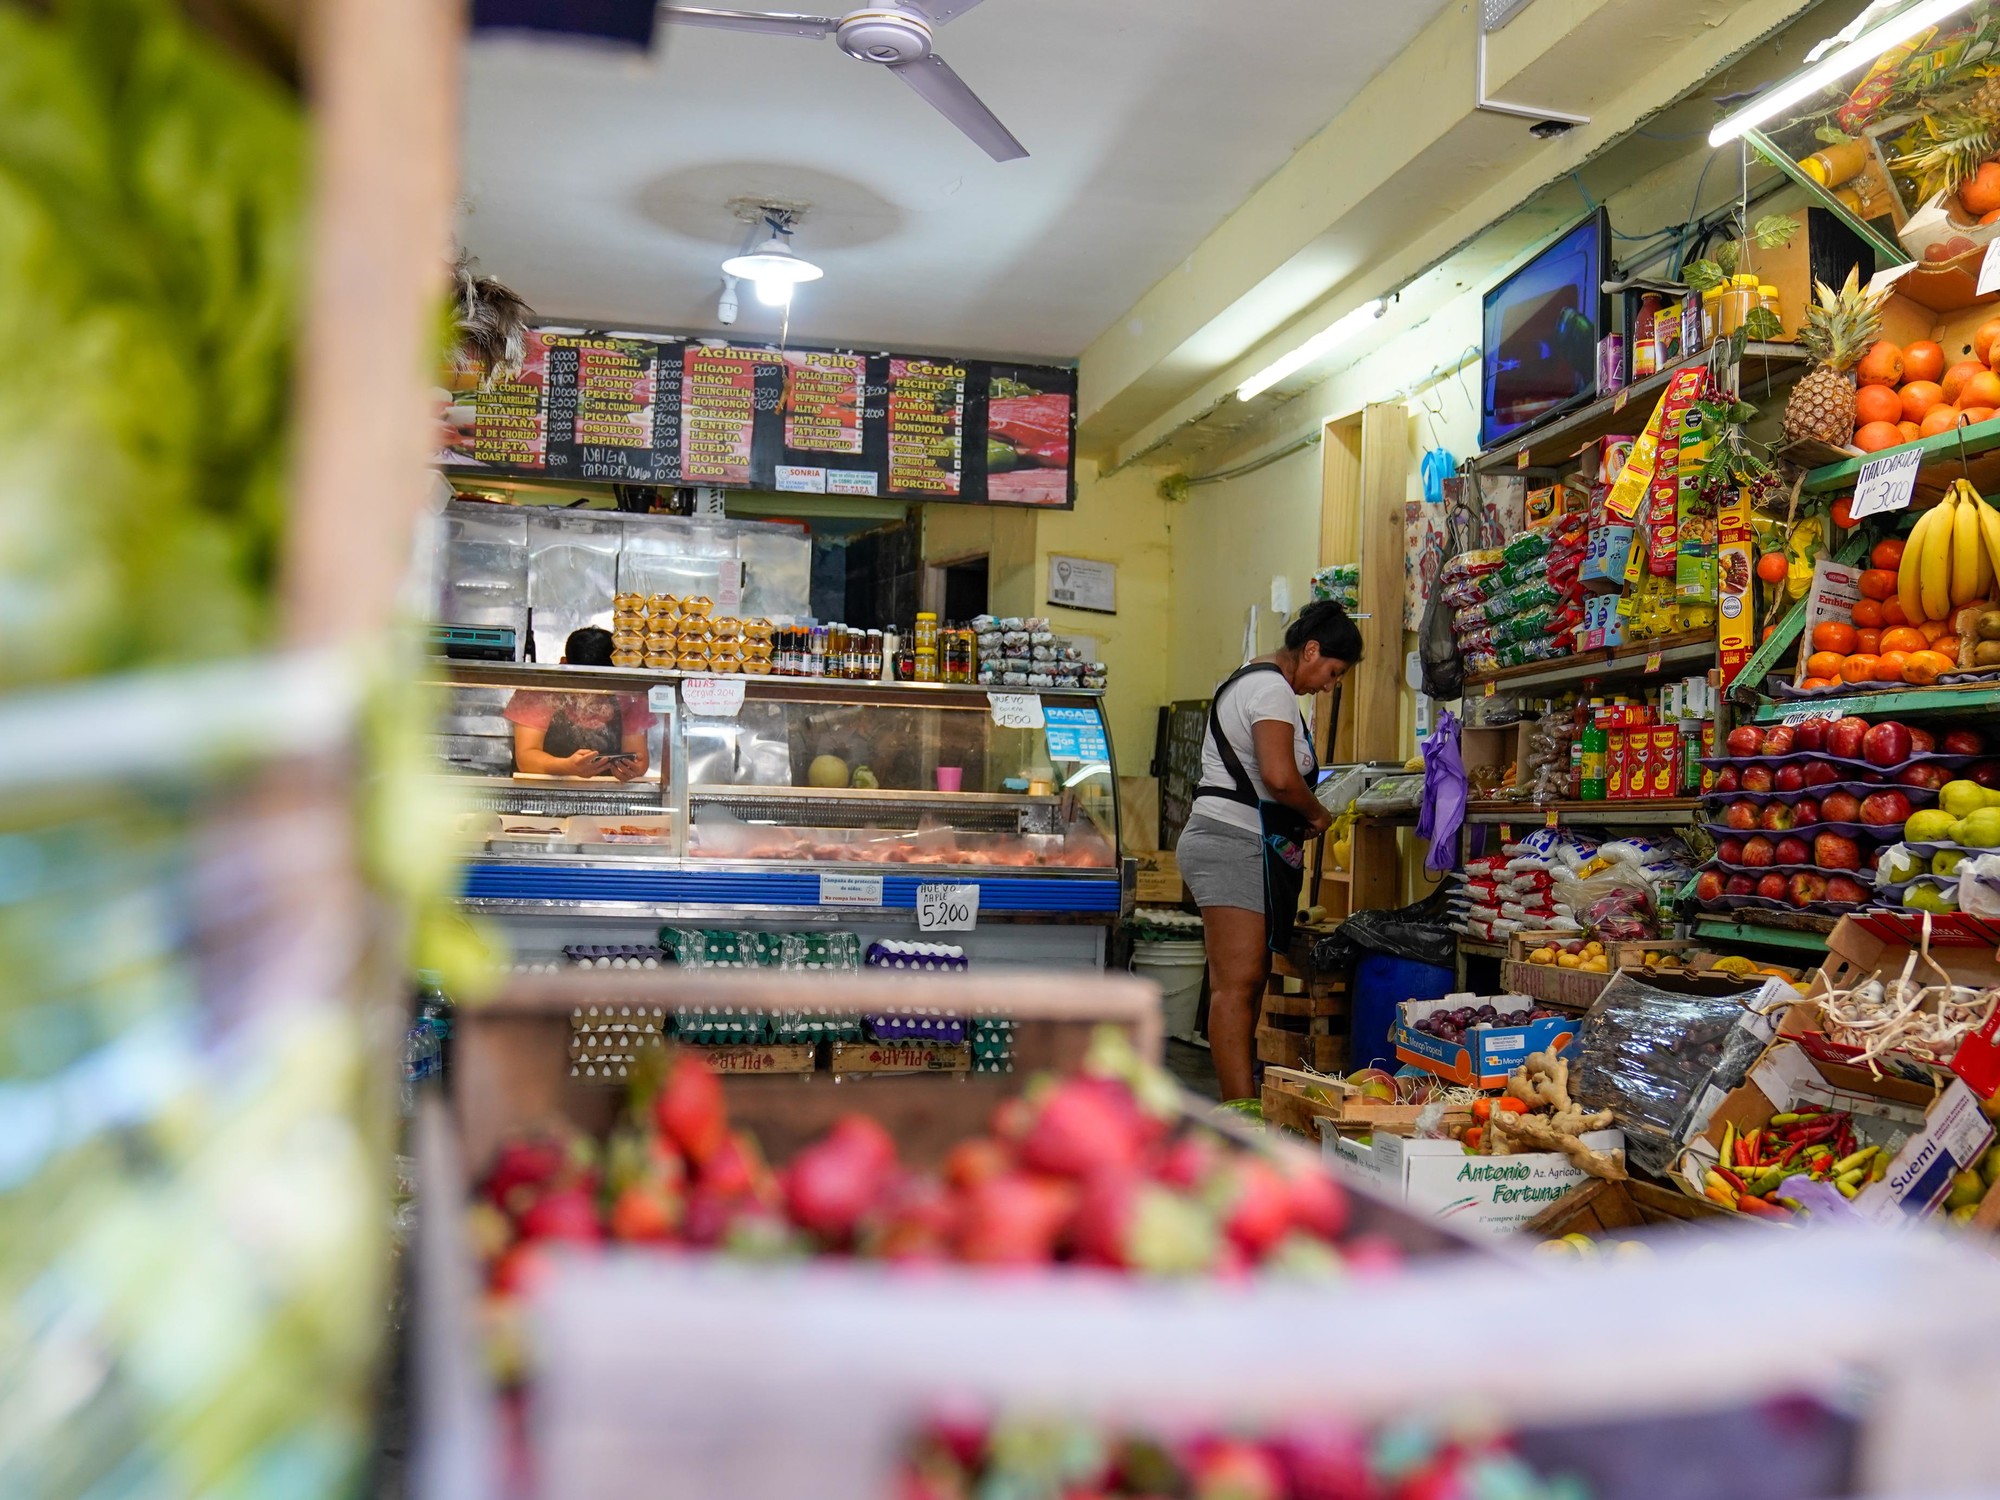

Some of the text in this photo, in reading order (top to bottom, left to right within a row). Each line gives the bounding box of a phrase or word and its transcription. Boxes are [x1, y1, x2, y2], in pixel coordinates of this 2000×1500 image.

[541, 334, 616, 350] Carnes
[698, 345, 783, 363] Achuras
[586, 355, 641, 367] CUADRIL
[806, 354, 858, 369] Pollo
[693, 363, 743, 375] HÍGADO
[906, 361, 967, 377] Cerdo
[692, 374, 733, 385] RIÑÓN
[795, 371, 854, 383] POLLO ENTERO
[499, 383, 539, 394] COSTILLA
[795, 383, 844, 394] PATA MUSLO
[895, 379, 947, 391] PECHITO
[585, 389, 634, 401] PECETO
[692, 386, 752, 397] CHINCHULÍN
[895, 390, 935, 401] CARRE
[691, 397, 751, 409] MONDONGO
[795, 394, 837, 404] SUPREMAS
[477, 405, 537, 417] MATAMBRE
[608, 402, 643, 413] CUADRIL
[794, 405, 822, 414] ALITAS
[895, 401, 935, 412] JAMÓN
[584, 412, 630, 424] PICADA
[691, 408, 749, 420] CORAZÓN
[894, 412, 950, 424] MATAMBRE
[476, 417, 537, 429] ENTRAÑA
[690, 420, 743, 431] CENTRO
[793, 416, 842, 427] PATY CARNE
[486, 429, 498, 438] DE
[499, 430, 538, 441] CHORIZO
[583, 424, 643, 436] OSOBUCO
[793, 427, 841, 438] PATY POLLO
[894, 423, 944, 435] BONDIOLA
[583, 435, 643, 447] ESPINAZO
[690, 431, 742, 442] LENGUA
[894, 434, 938, 445] PALETA
[1681, 436, 1700, 444] Knorr
[475, 440, 529, 452] PALETA
[690, 442, 734, 453] RUEDA
[793, 438, 852, 450] MILANESA POLLO
[893, 445, 950, 457] CHORIZO CASERO
[474, 452, 536, 464] ROAST BEEF
[650, 452, 681, 468] 15000
[689, 454, 749, 466] MOLLEJA
[893, 456, 922, 466] CHORIZO
[689, 465, 725, 475] RABO
[892, 467, 921, 477] CHORIZO
[892, 479, 946, 490] MORCILLA
[998, 714, 1031, 725] 1500
[921, 884, 957, 893] HUEVO
[924, 893, 947, 902] MAPLE
[922, 902, 968, 927] 5200
[882, 1050, 922, 1066] PILAR
[1824, 1049, 1851, 1061] miss
[1457, 1162, 1531, 1182] Antonio
[1533, 1169, 1546, 1178] Az.
[1890, 1138, 1937, 1195] Suemi
[1492, 1183, 1573, 1204] Fortunat
